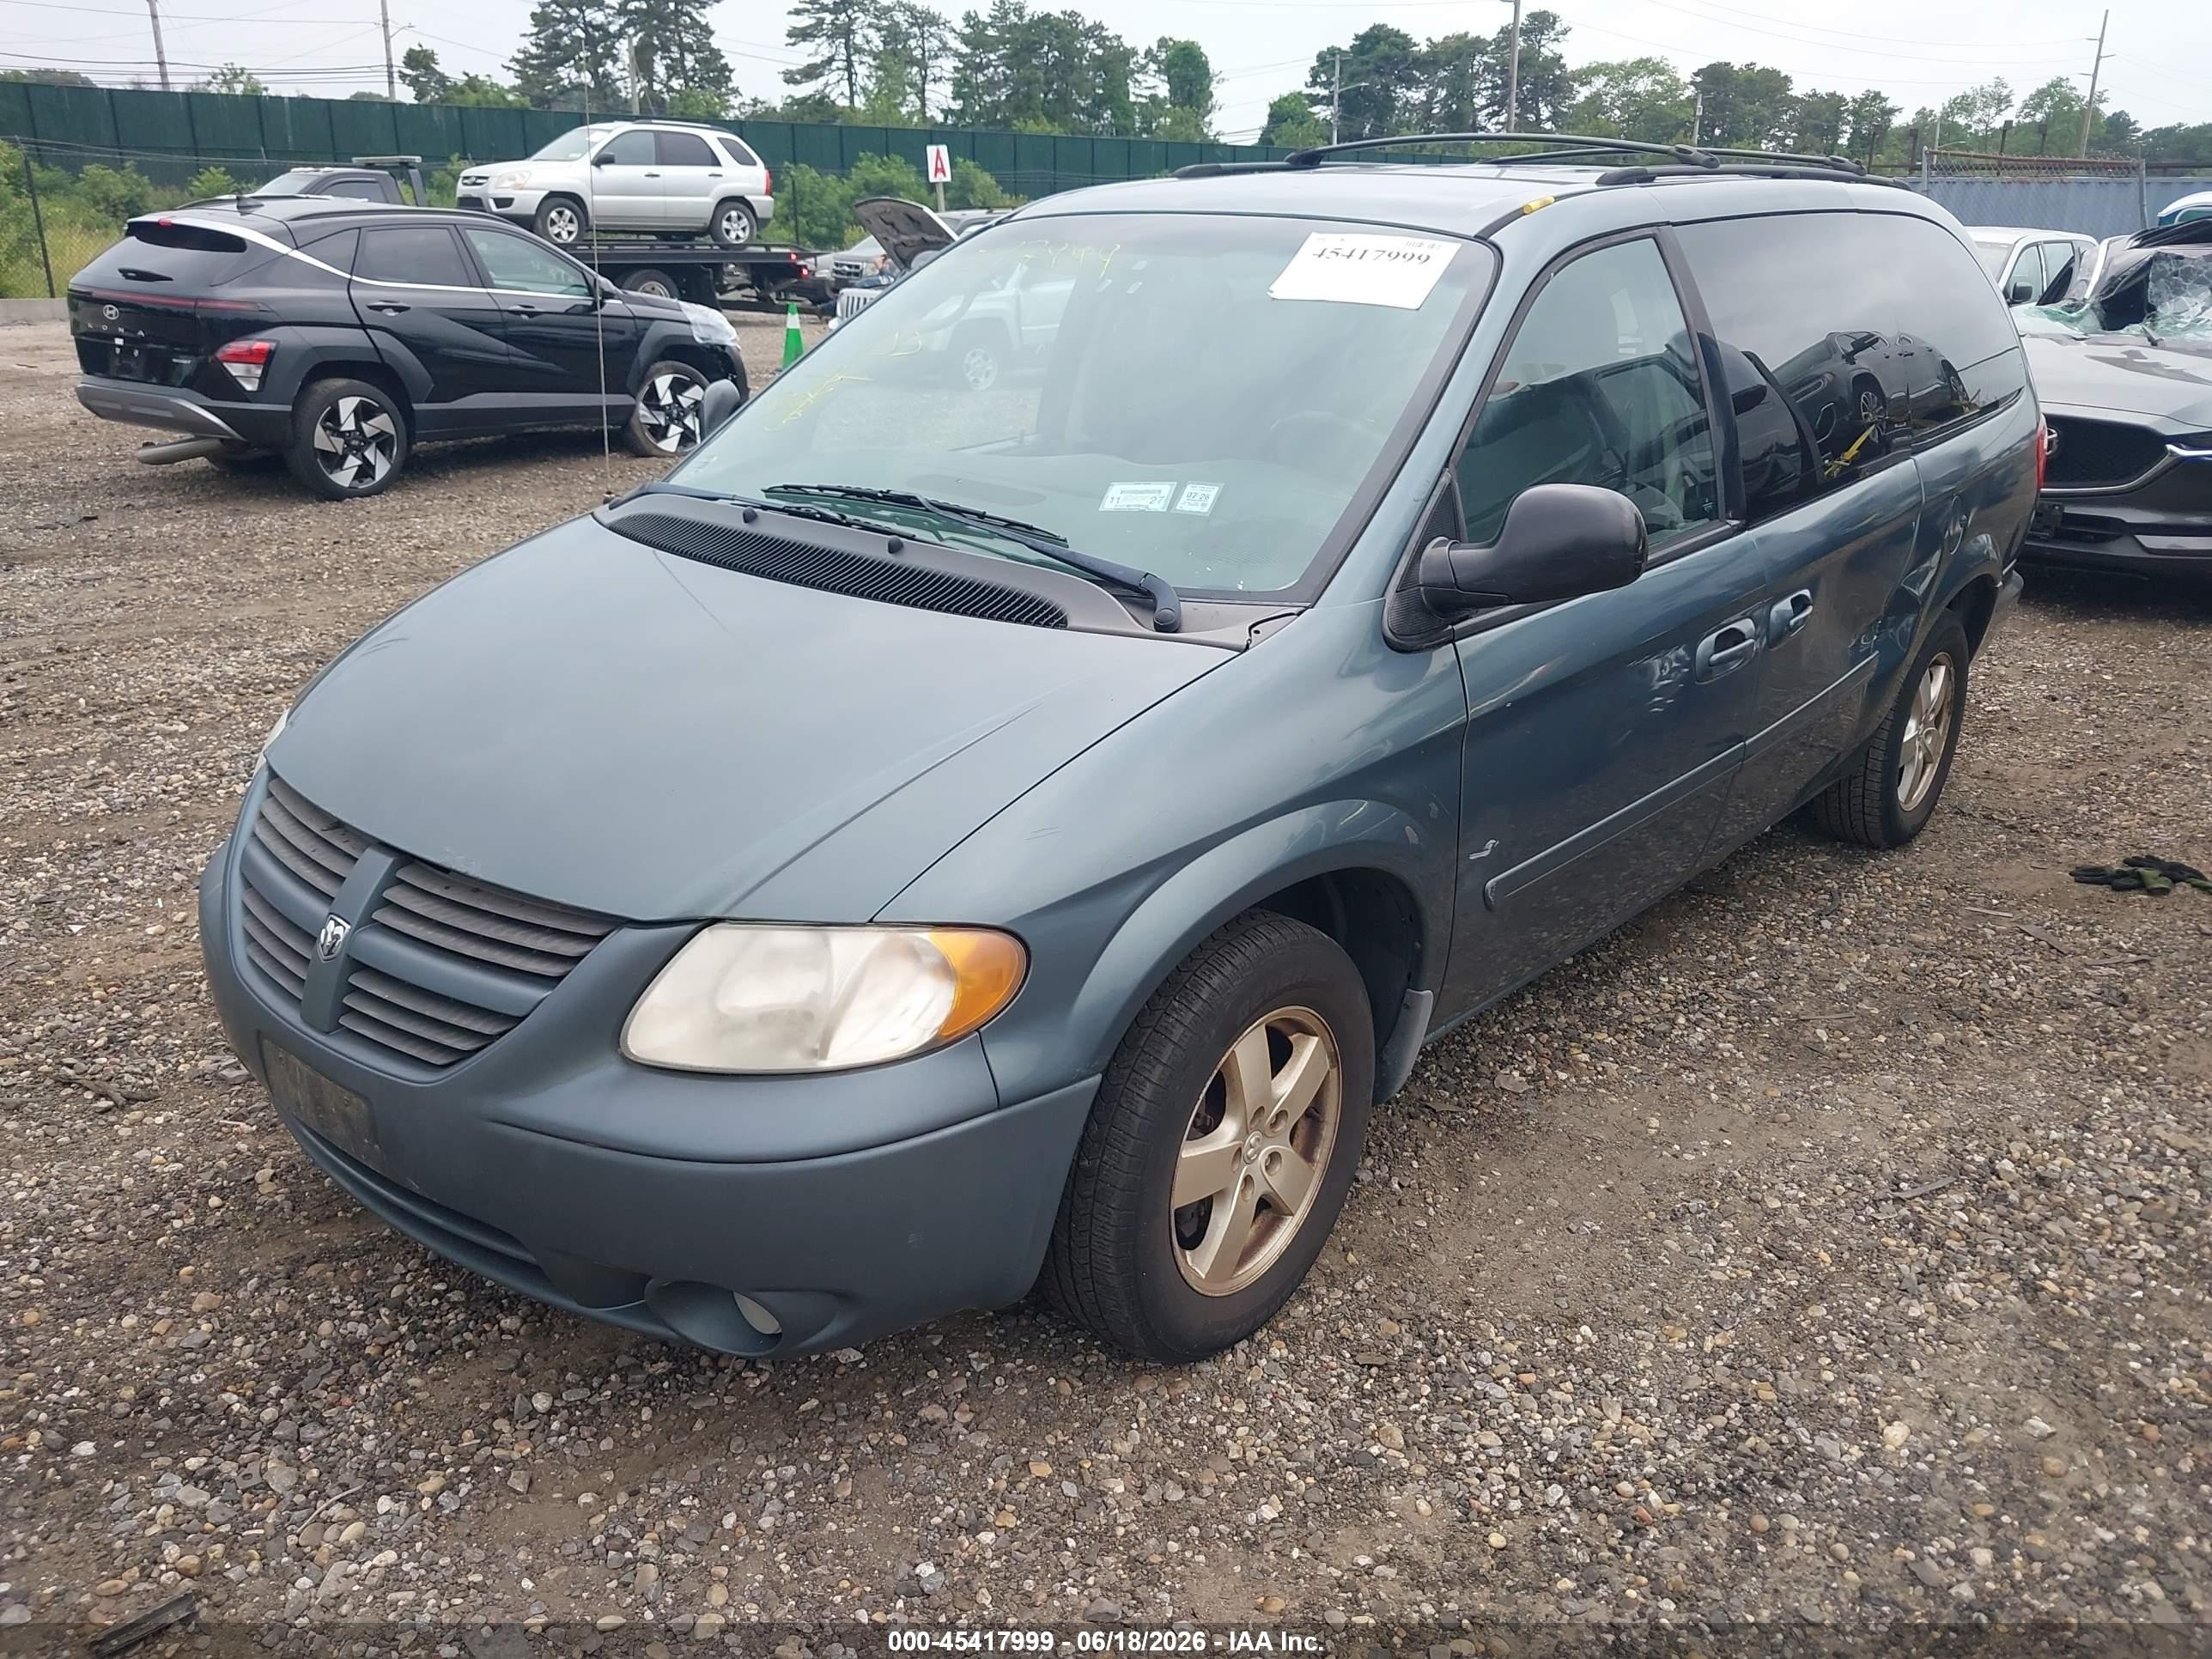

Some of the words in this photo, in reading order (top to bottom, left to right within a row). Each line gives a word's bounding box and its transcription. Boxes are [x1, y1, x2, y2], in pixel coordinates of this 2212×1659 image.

[933, 147, 946, 179] A
[1312, 247, 1431, 264] 45417999
[88, 323, 145, 337] KONA
[1149, 495, 1165, 505] 27
